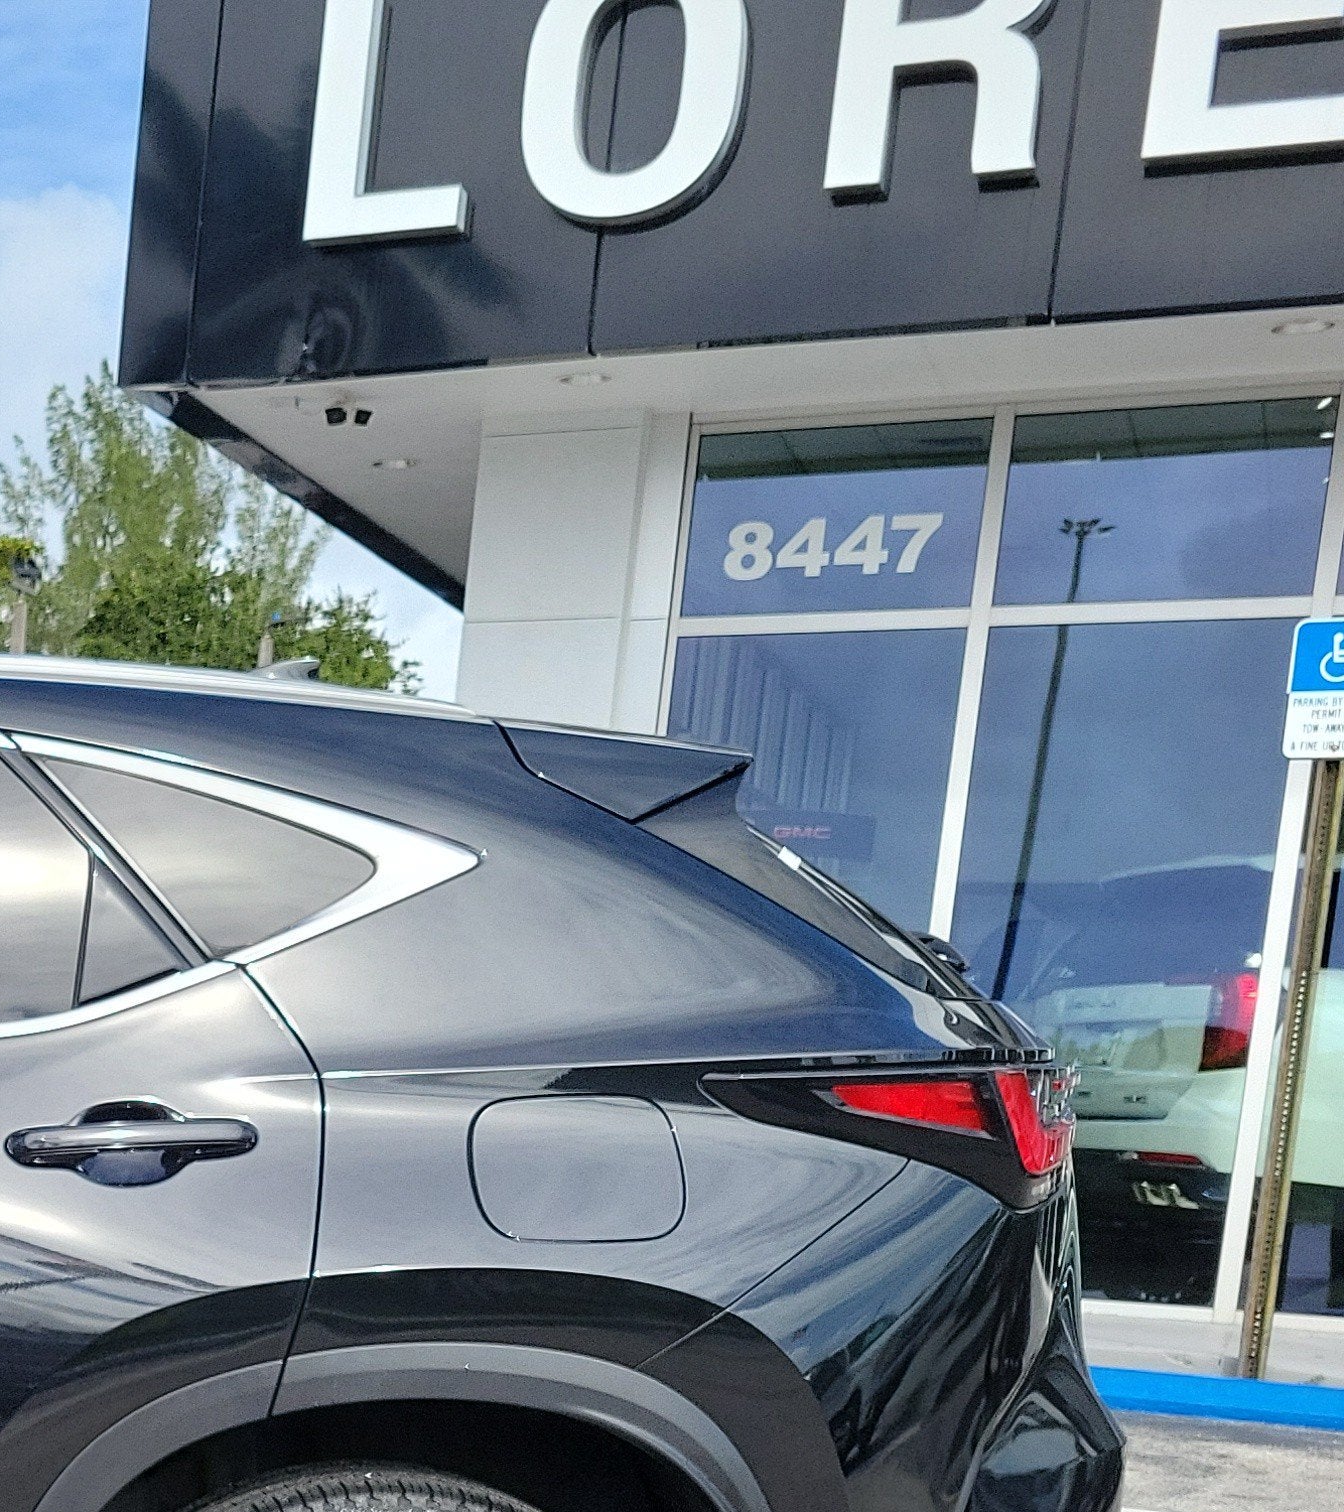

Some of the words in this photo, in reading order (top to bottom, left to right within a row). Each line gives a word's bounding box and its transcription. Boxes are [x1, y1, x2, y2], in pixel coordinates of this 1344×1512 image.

[723, 513, 945, 581] 8447
[1292, 697, 1329, 707] PARKING
[1332, 697, 1344, 706] BY
[1311, 709, 1342, 719] PERMIT
[1300, 741, 1318, 751] FINE
